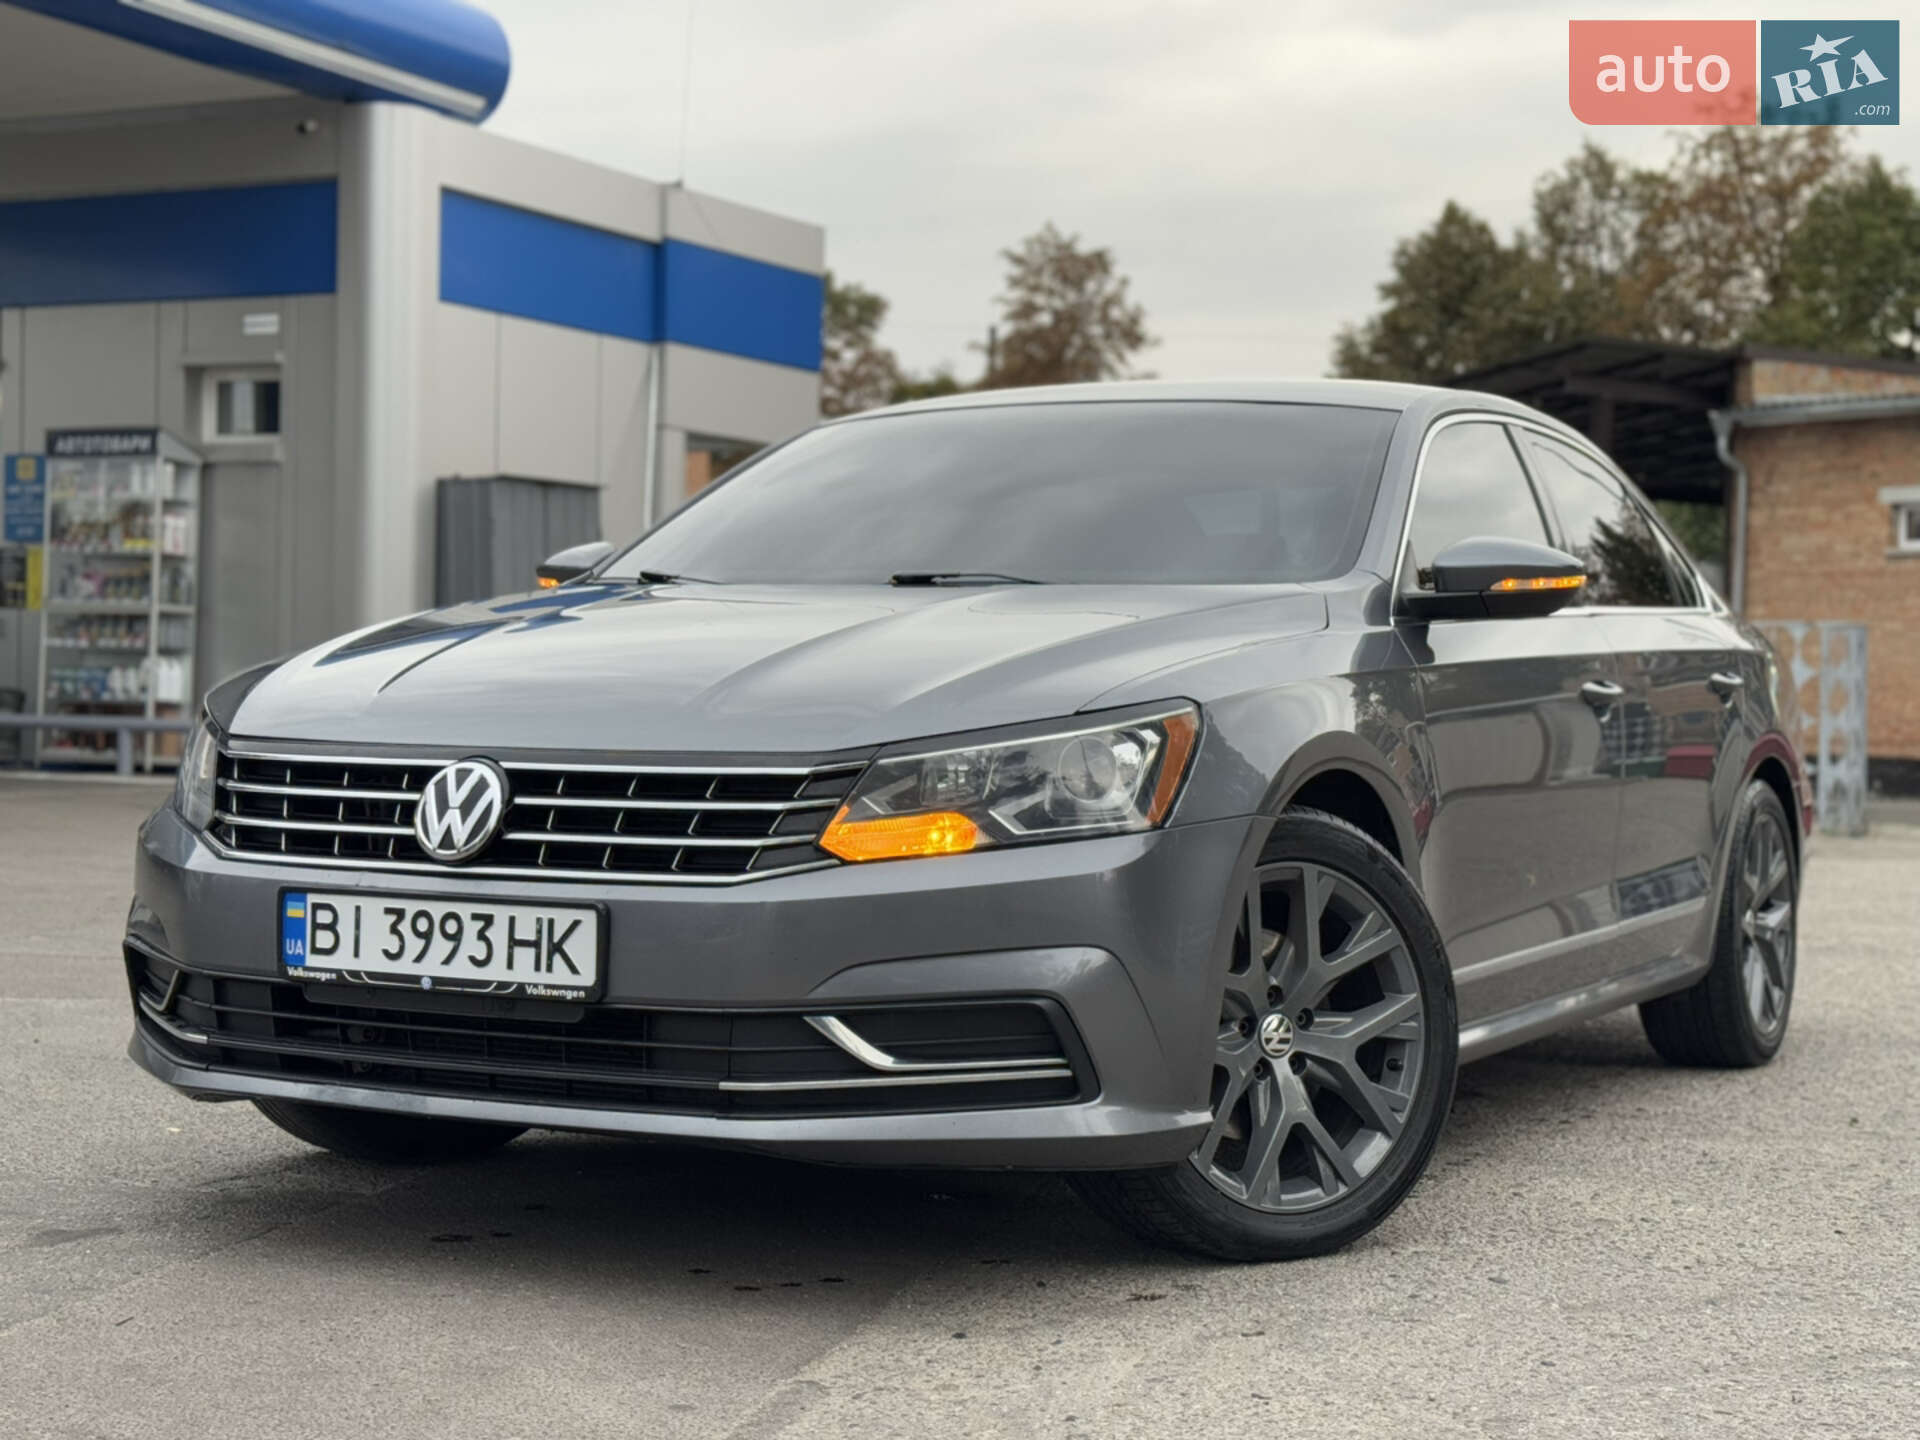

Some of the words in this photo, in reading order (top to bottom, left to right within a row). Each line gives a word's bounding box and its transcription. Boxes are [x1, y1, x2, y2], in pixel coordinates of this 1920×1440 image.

[286, 938, 304, 956] UA
[310, 902, 361, 959] BI
[381, 907, 494, 968] 3993
[506, 915, 582, 976] HK
[286, 966, 337, 981] Volkswagen
[525, 984, 586, 999] Volkswagen
